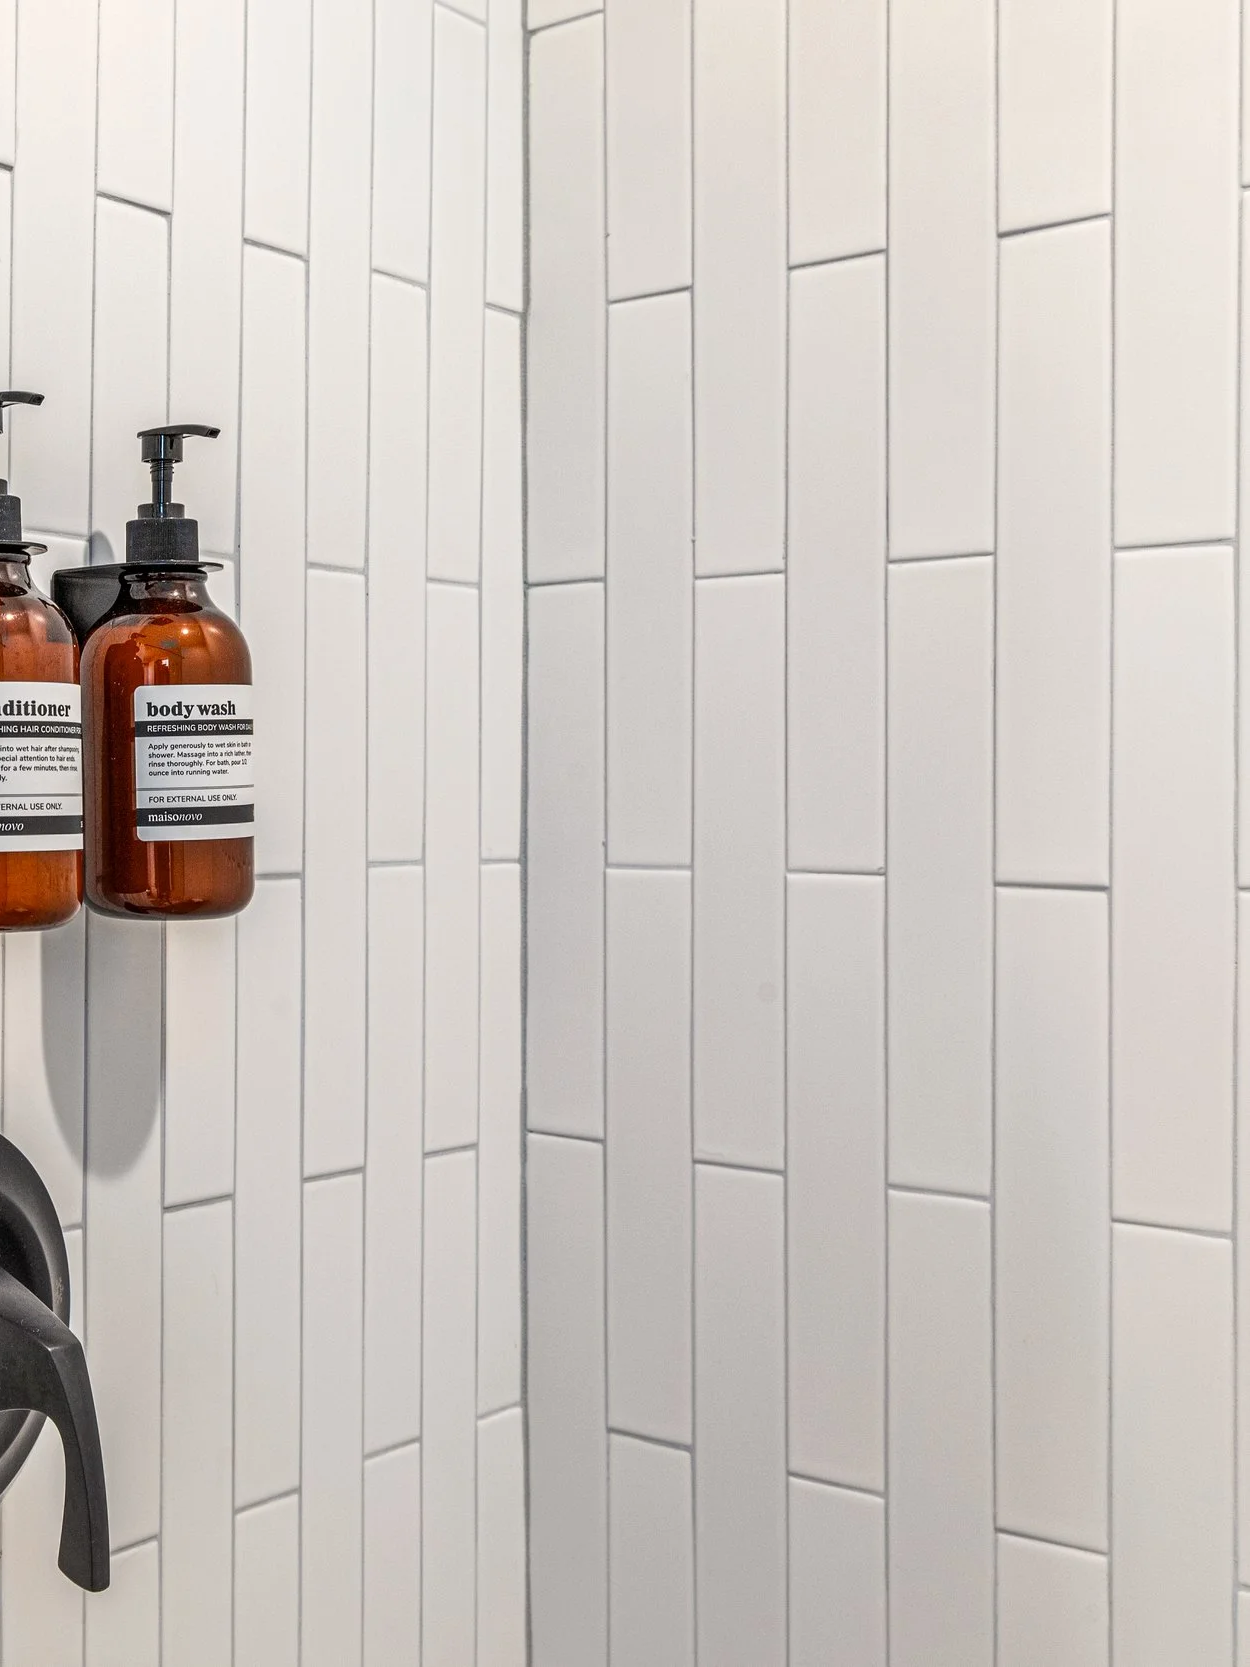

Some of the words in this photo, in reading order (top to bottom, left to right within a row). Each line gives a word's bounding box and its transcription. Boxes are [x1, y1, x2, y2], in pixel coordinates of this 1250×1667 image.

[147, 701, 194, 718] body
[197, 701, 236, 716] wash
[34, 764, 58, 772] minutes,
[149, 812, 202, 822] maisonovo
